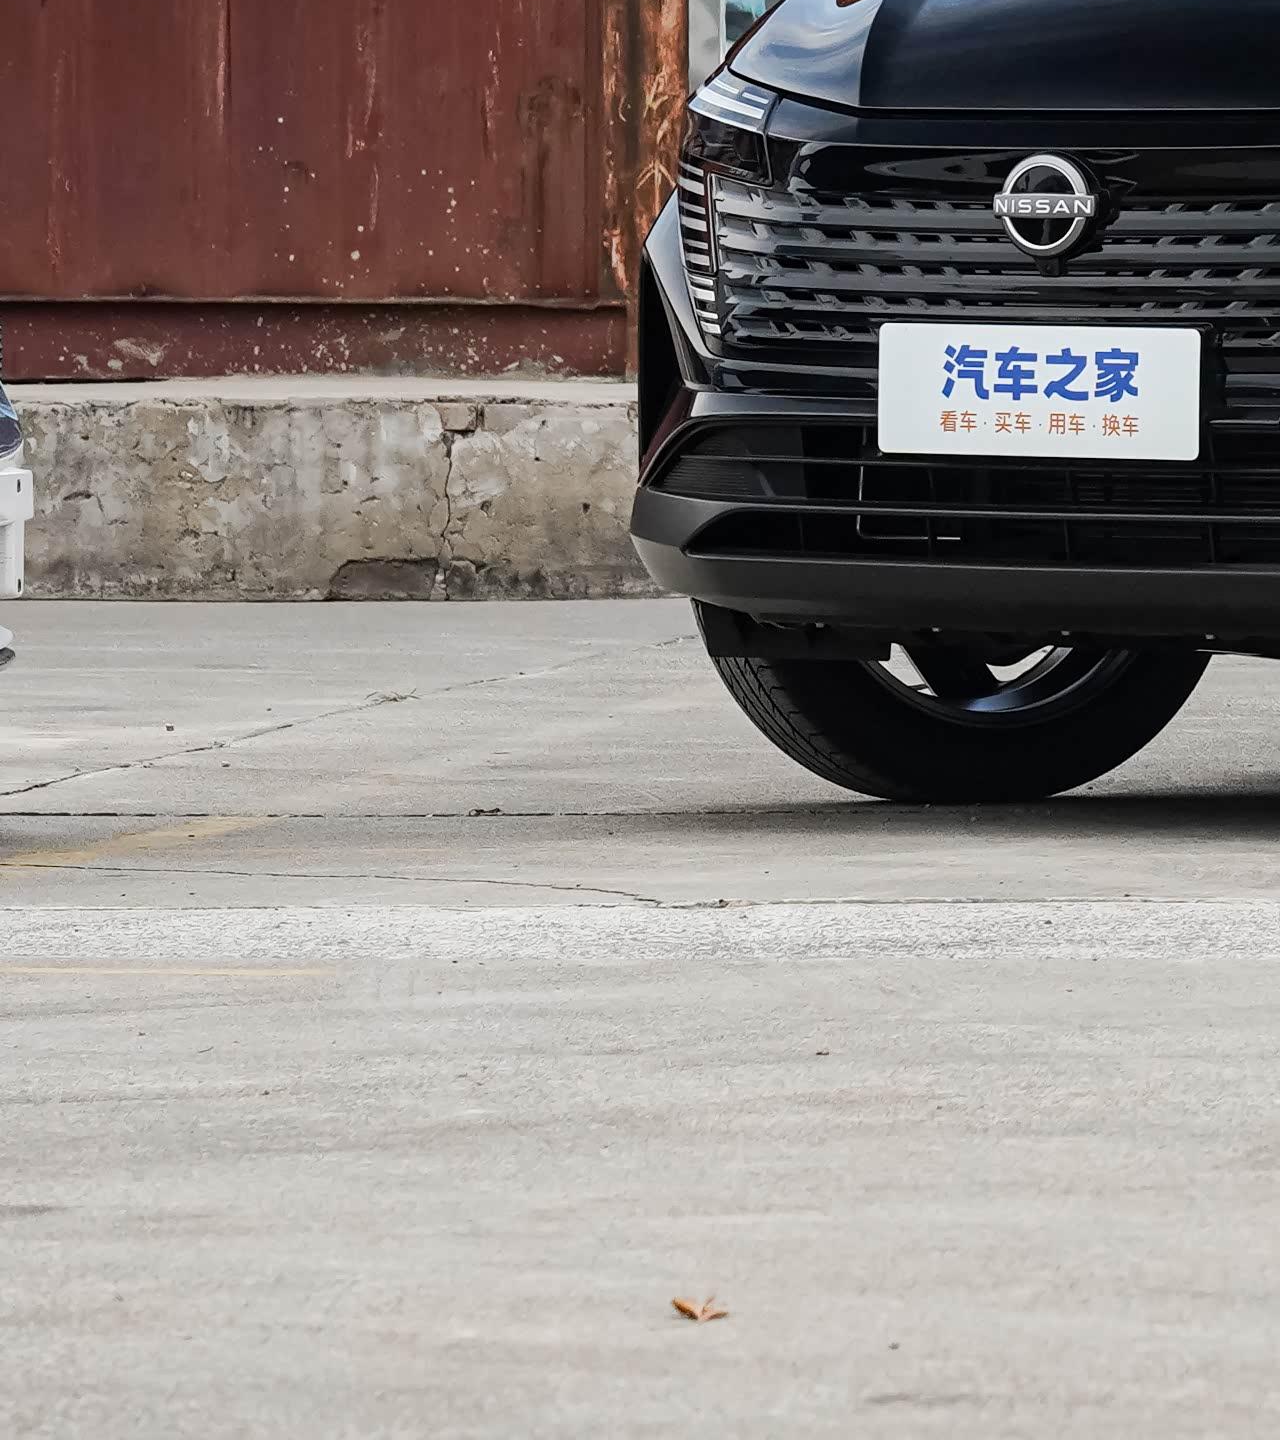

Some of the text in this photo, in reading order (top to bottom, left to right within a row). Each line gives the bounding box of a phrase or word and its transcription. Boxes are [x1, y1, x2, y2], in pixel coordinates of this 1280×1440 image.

[994, 198, 1093, 215] NISSAN
[941, 344, 1140, 403] 汽车之家
[939, 411, 1140, 437] 看车 买车 用车 换车
